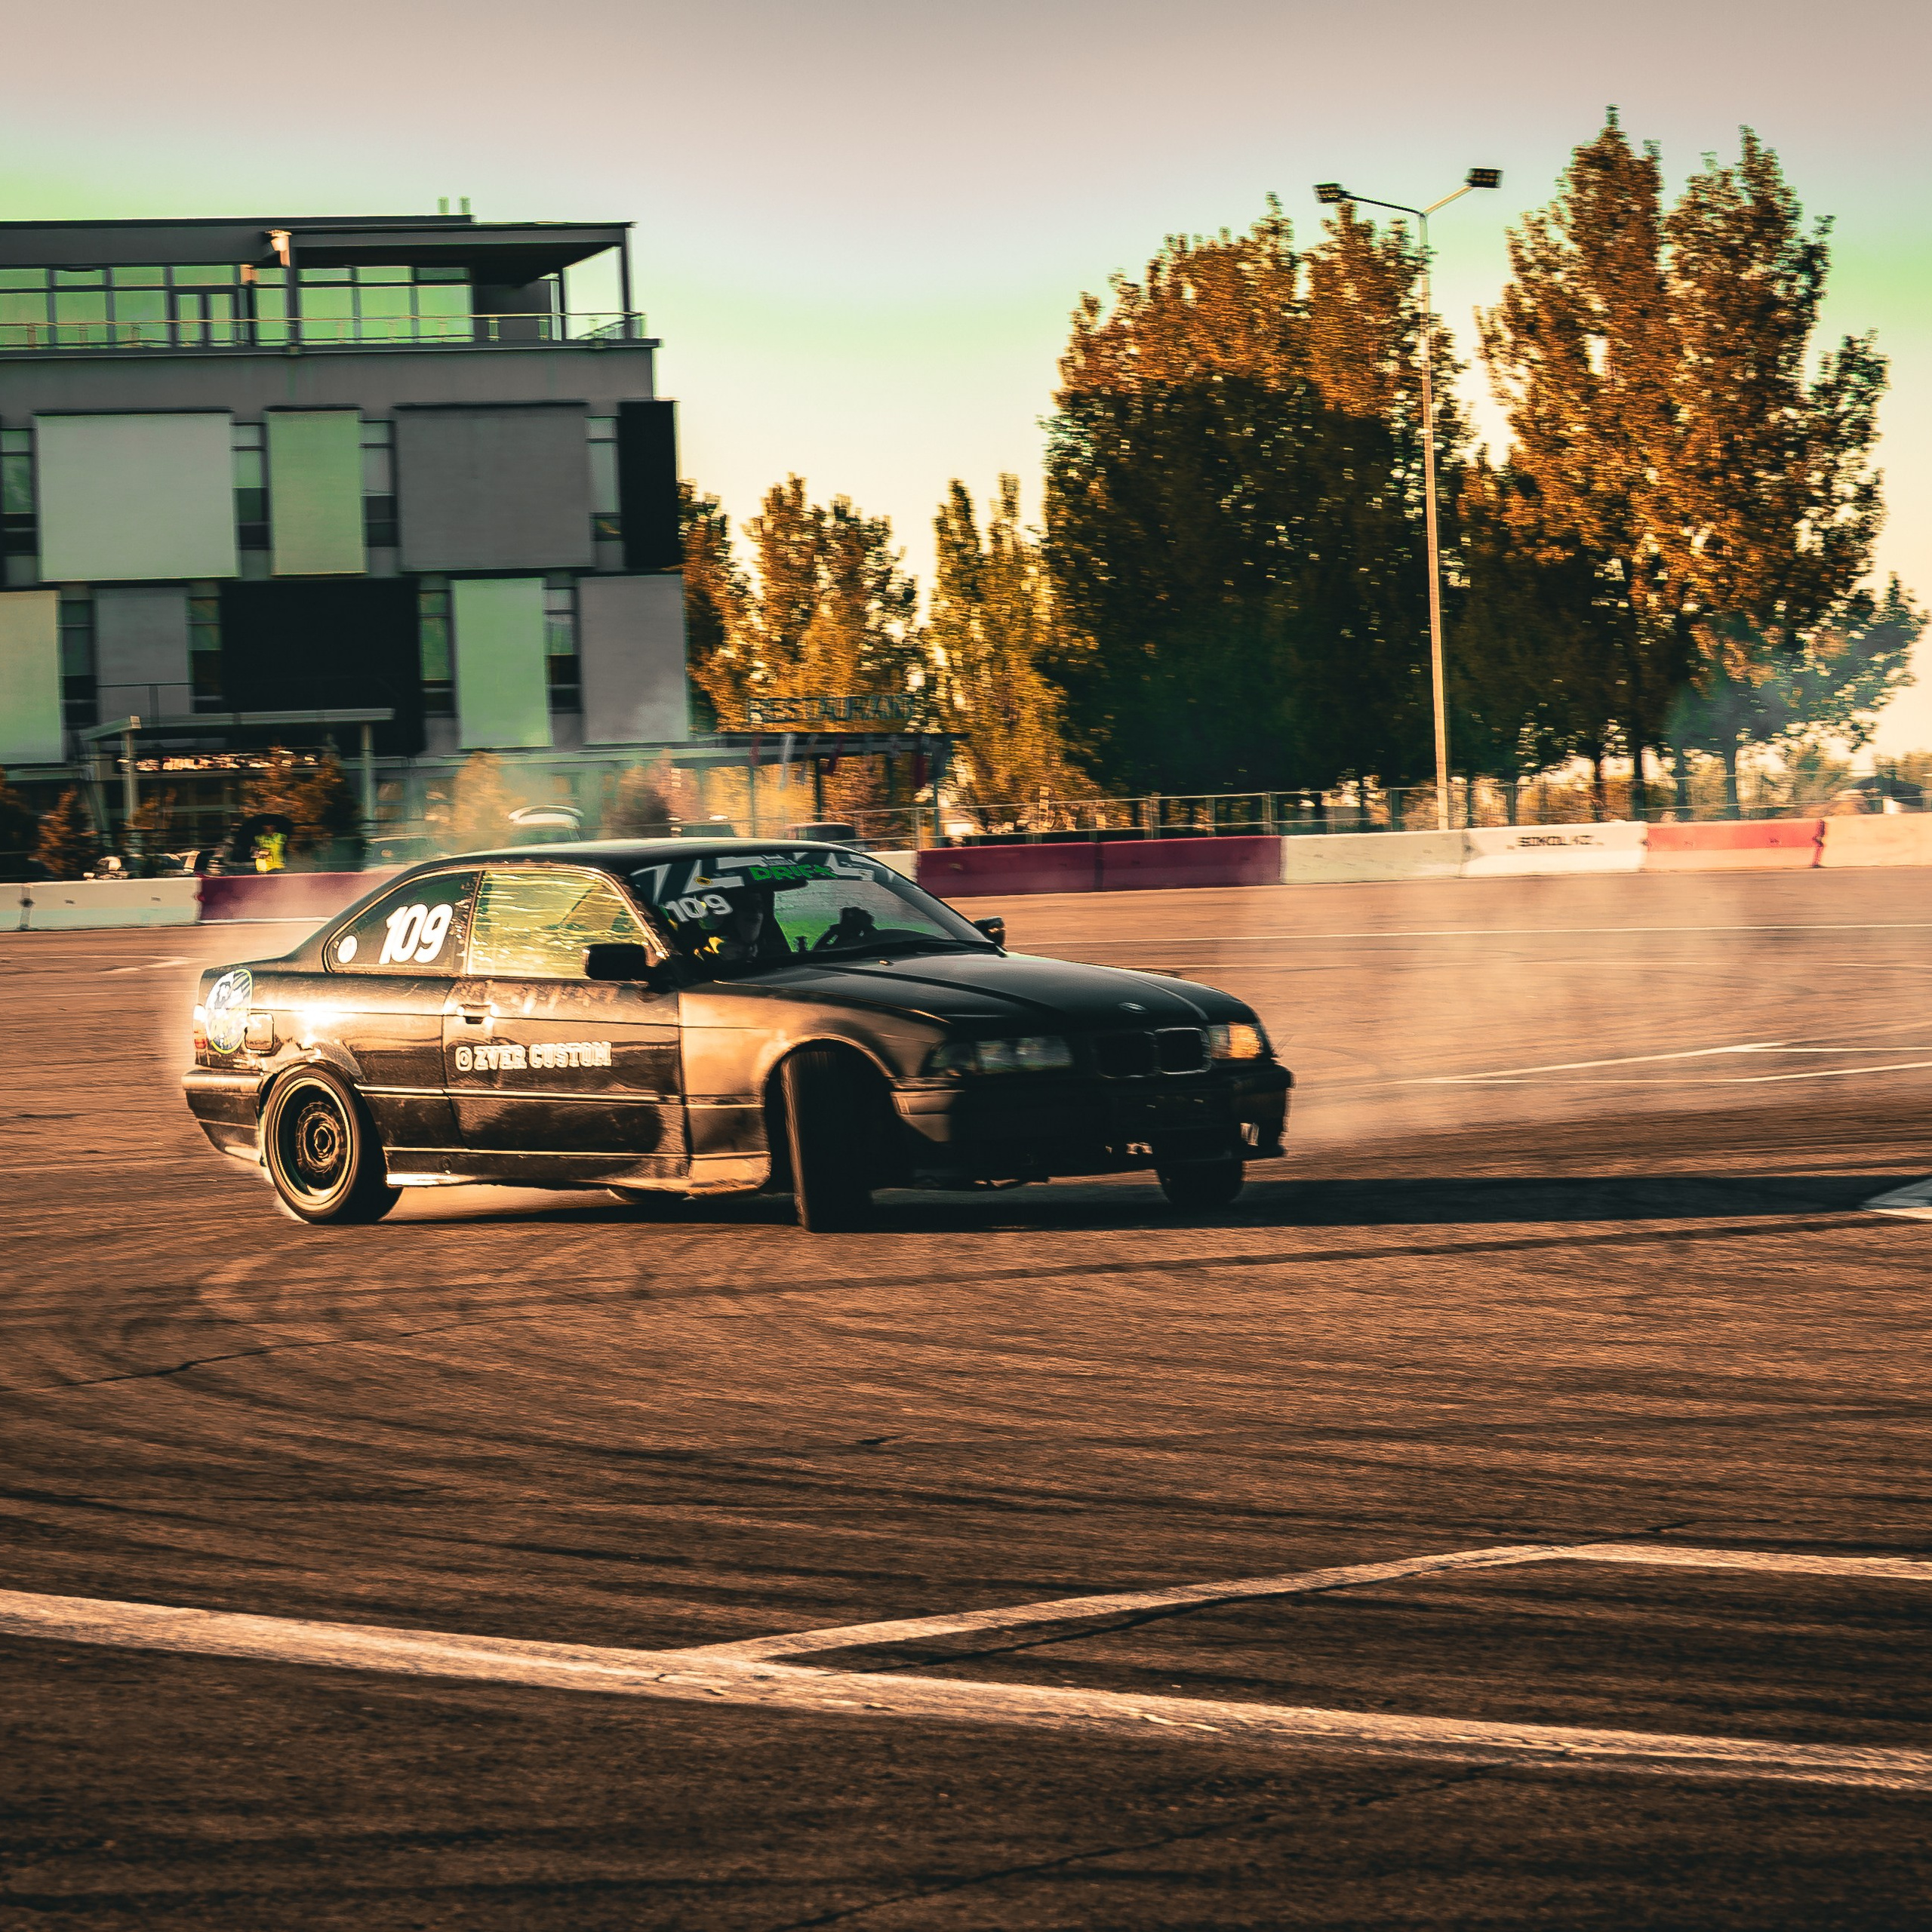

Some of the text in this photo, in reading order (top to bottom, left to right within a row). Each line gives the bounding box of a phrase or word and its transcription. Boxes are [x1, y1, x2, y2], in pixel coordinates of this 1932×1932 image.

[663, 892, 734, 922] 109
[379, 904, 453, 965] 109
[529, 1041, 612, 1069] CUSTOM
